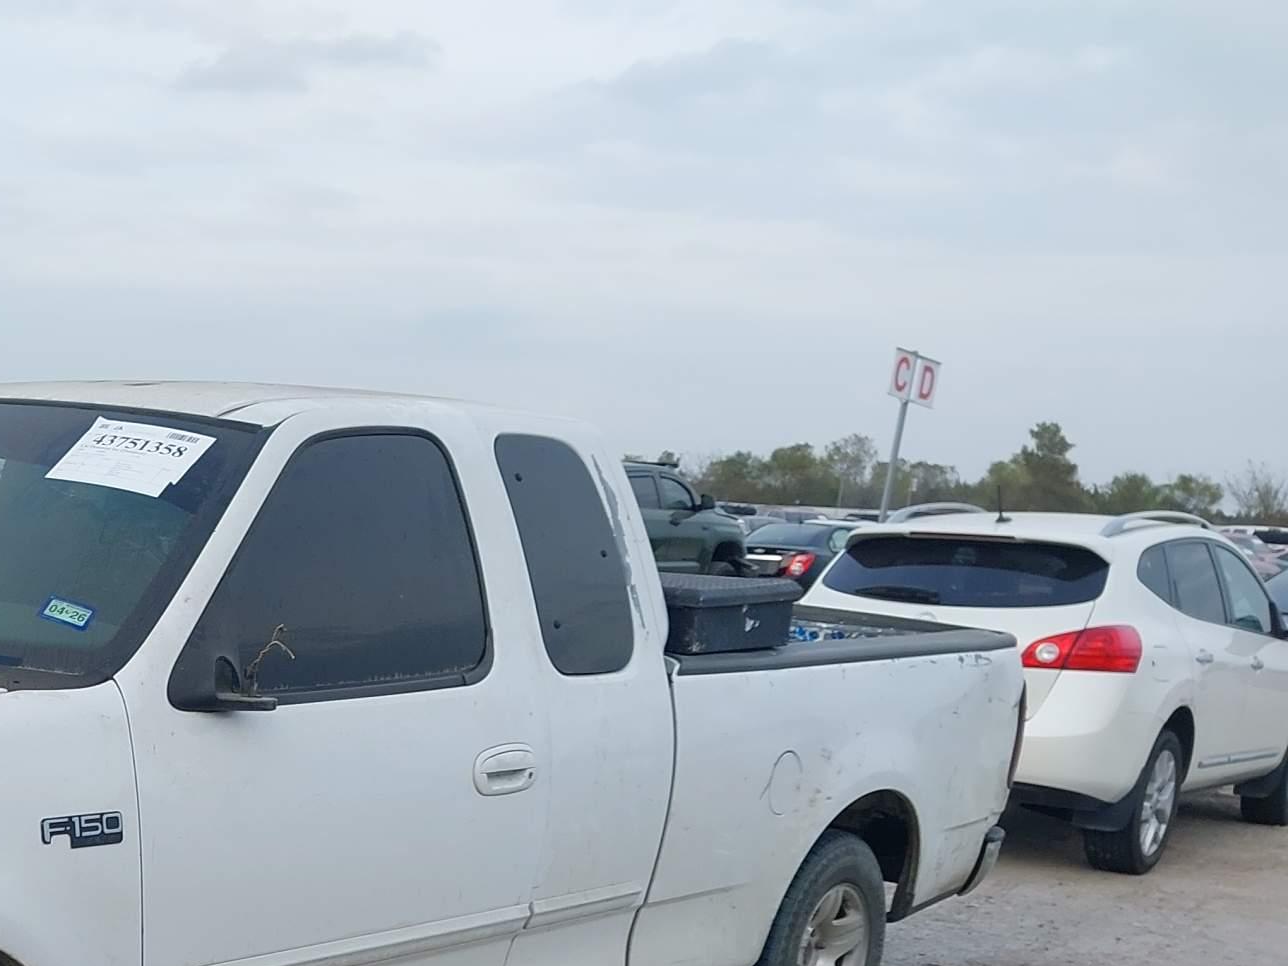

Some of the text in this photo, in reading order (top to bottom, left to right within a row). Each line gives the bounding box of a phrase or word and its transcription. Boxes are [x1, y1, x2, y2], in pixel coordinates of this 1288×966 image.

[895, 356, 911, 392] C
[919, 365, 935, 400] D
[93, 433, 188, 458] 43751358
